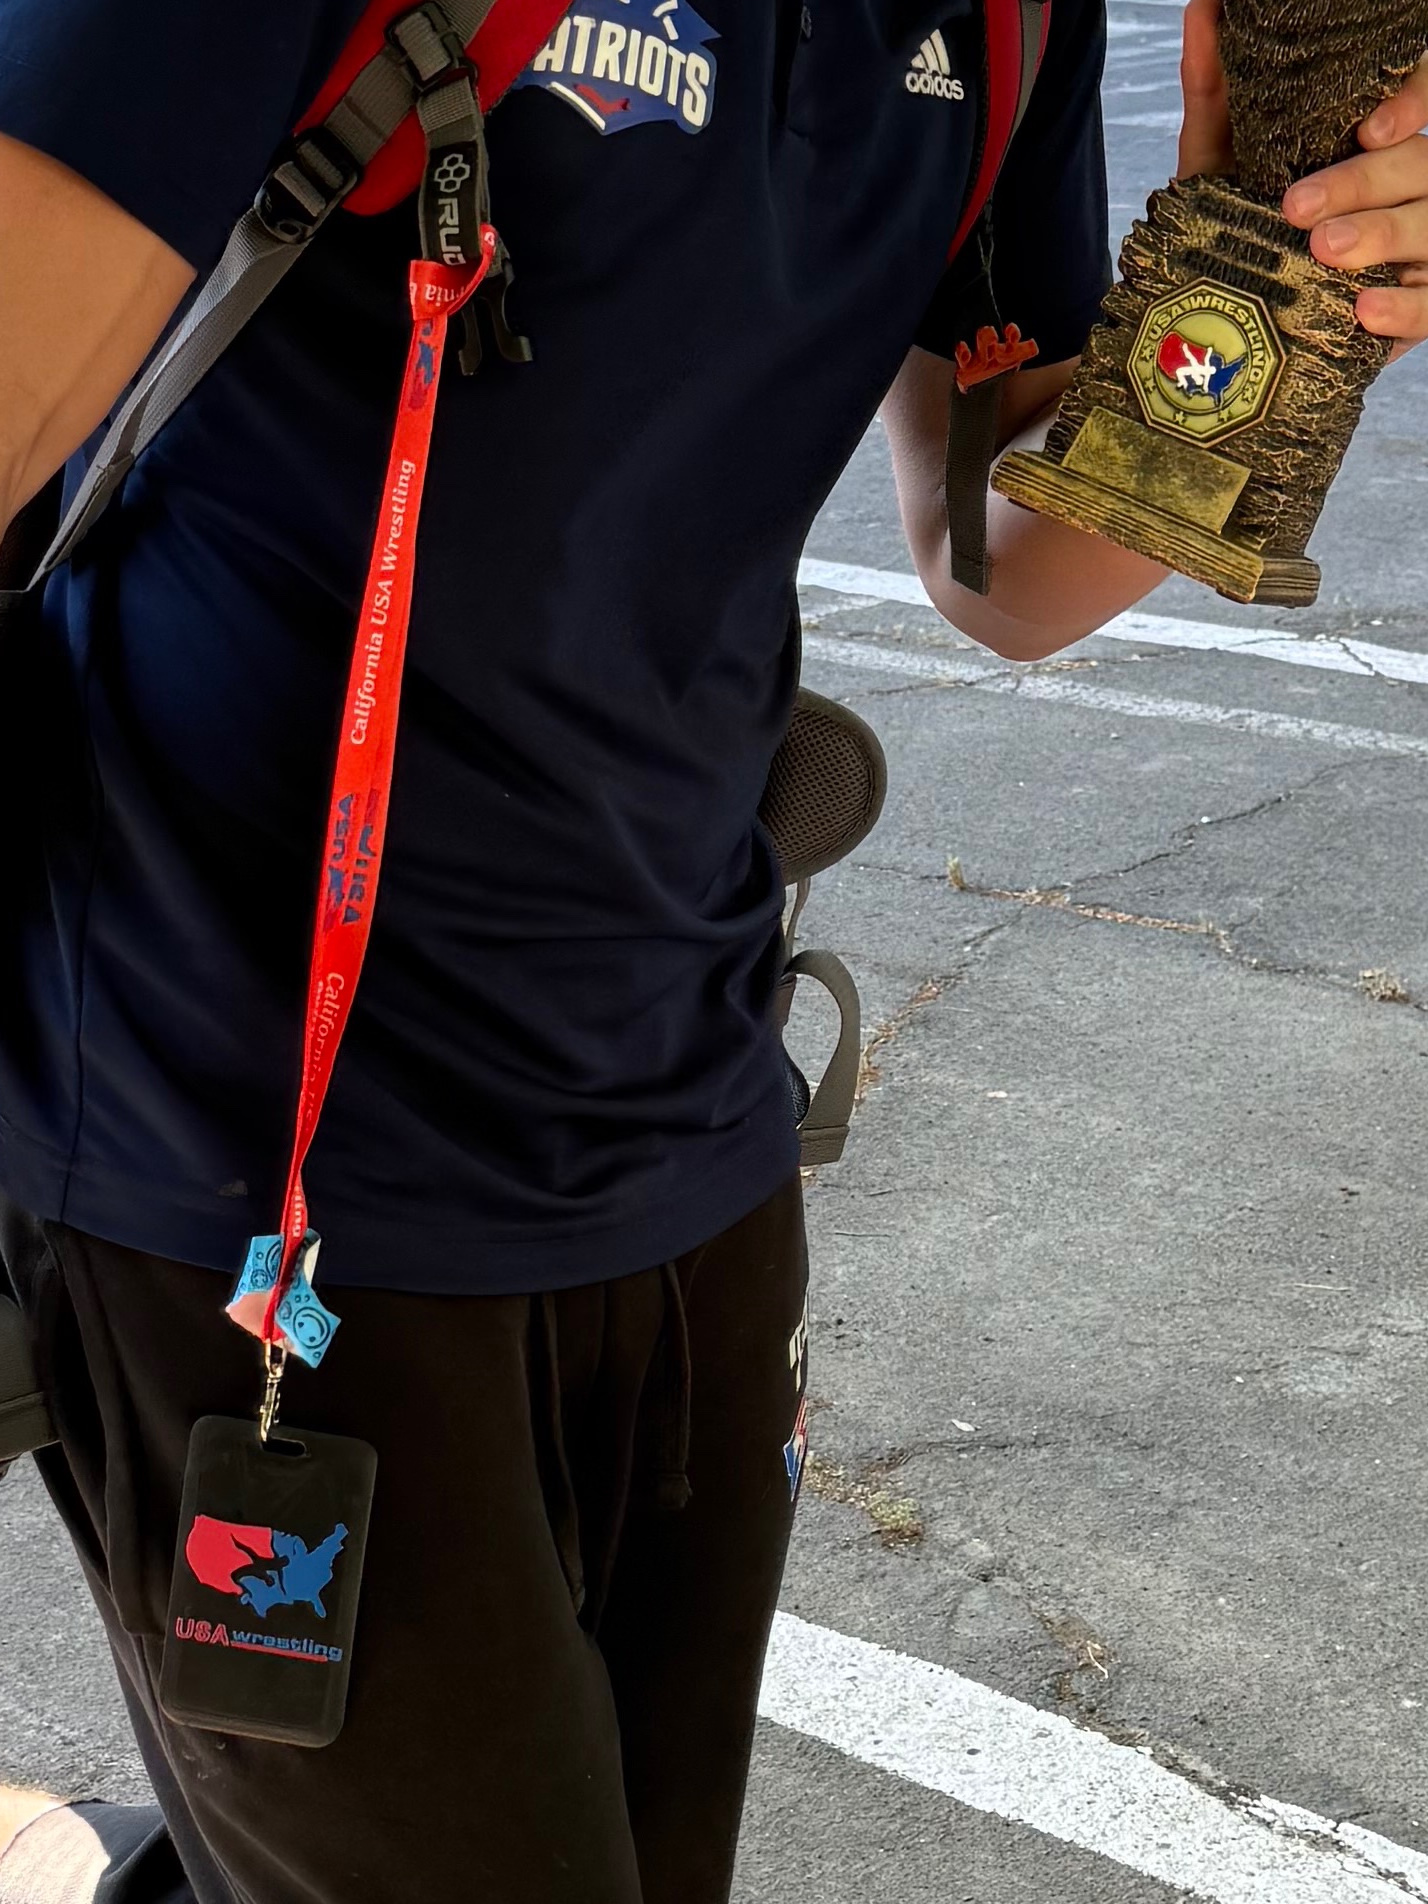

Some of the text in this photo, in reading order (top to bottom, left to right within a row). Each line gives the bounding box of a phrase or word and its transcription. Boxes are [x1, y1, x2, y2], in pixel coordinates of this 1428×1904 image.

[533, 15, 711, 128] ATRIOTS
[905, 67, 965, 101] adidas
[1149, 295, 1266, 384] USA WRESTLING
[350, 459, 416, 745] California USA Wrestling
[175, 1616, 344, 1663] USA wrestling
